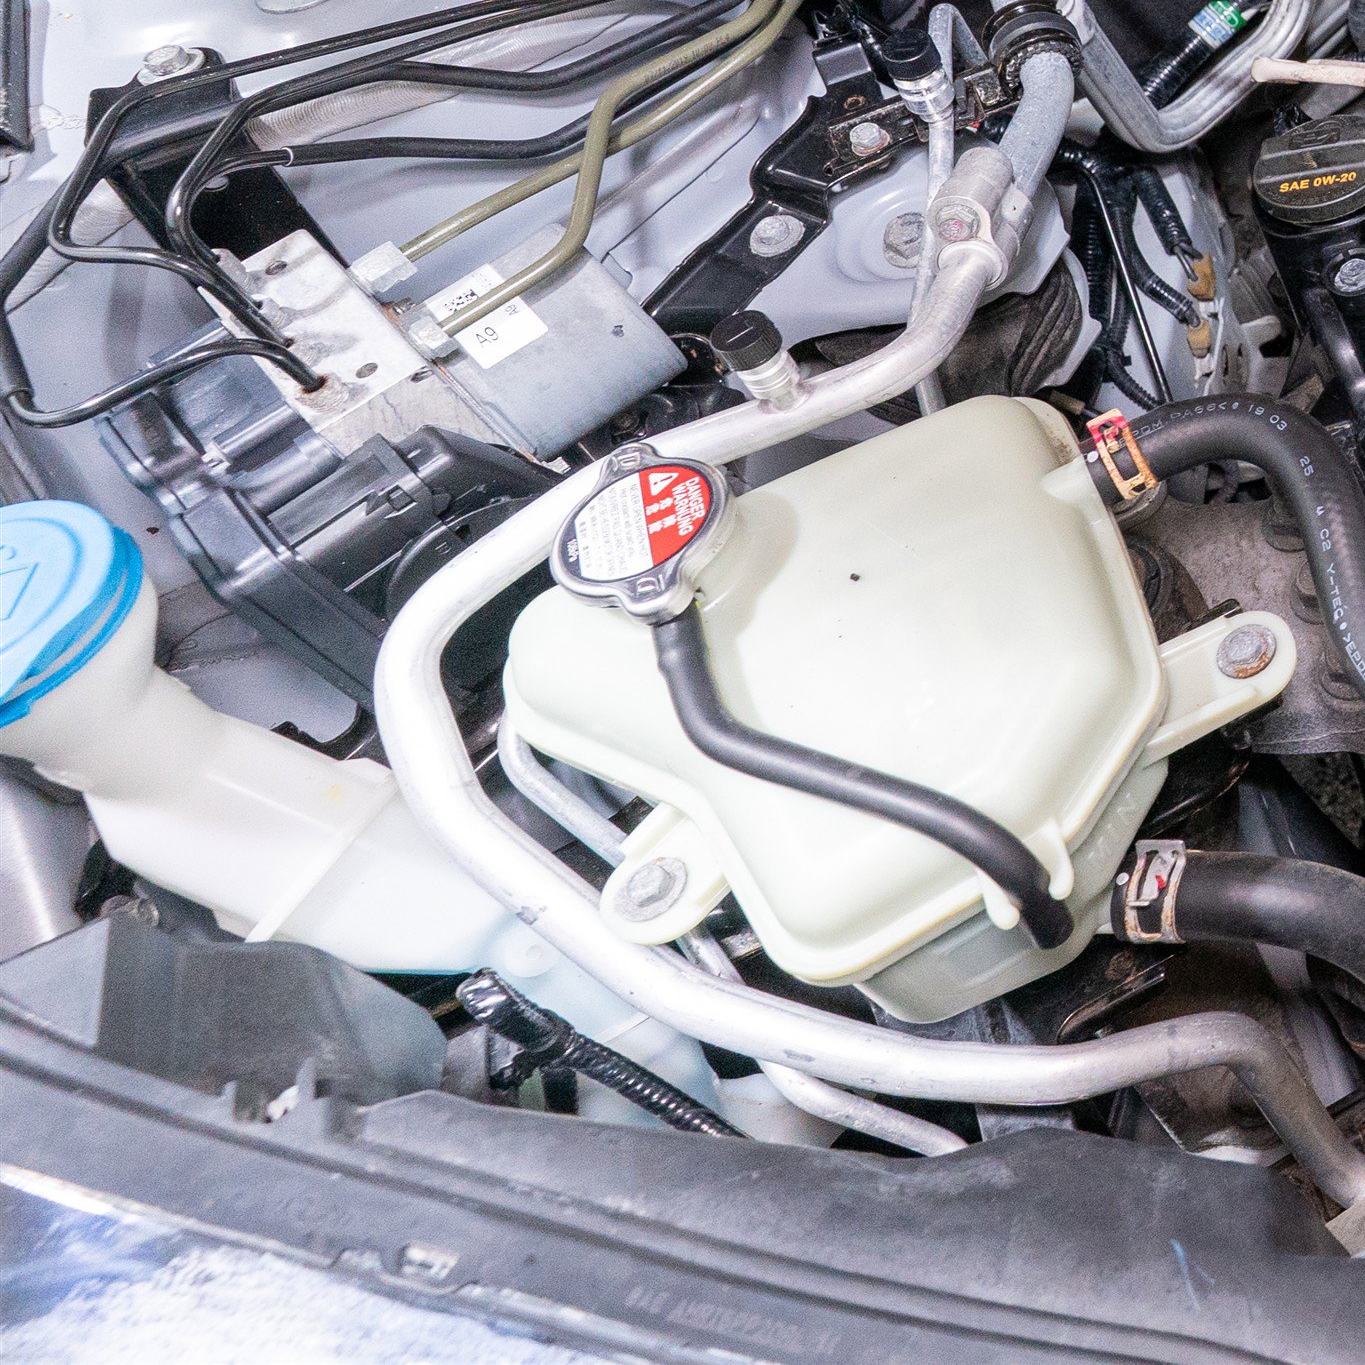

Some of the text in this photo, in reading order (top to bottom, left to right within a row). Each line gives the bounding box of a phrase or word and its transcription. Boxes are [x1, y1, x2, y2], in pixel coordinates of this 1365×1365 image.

[1279, 171, 1357, 193] SAE 0W-20
[475, 326, 499, 348] A9
[671, 483, 694, 536] WARNUNG
[684, 476, 705, 521] DANGER
[1269, 414, 1288, 431] 03
[1299, 455, 1315, 477] 25
[1319, 528, 1332, 551] C2
[1326, 563, 1347, 623] Y-TEC
